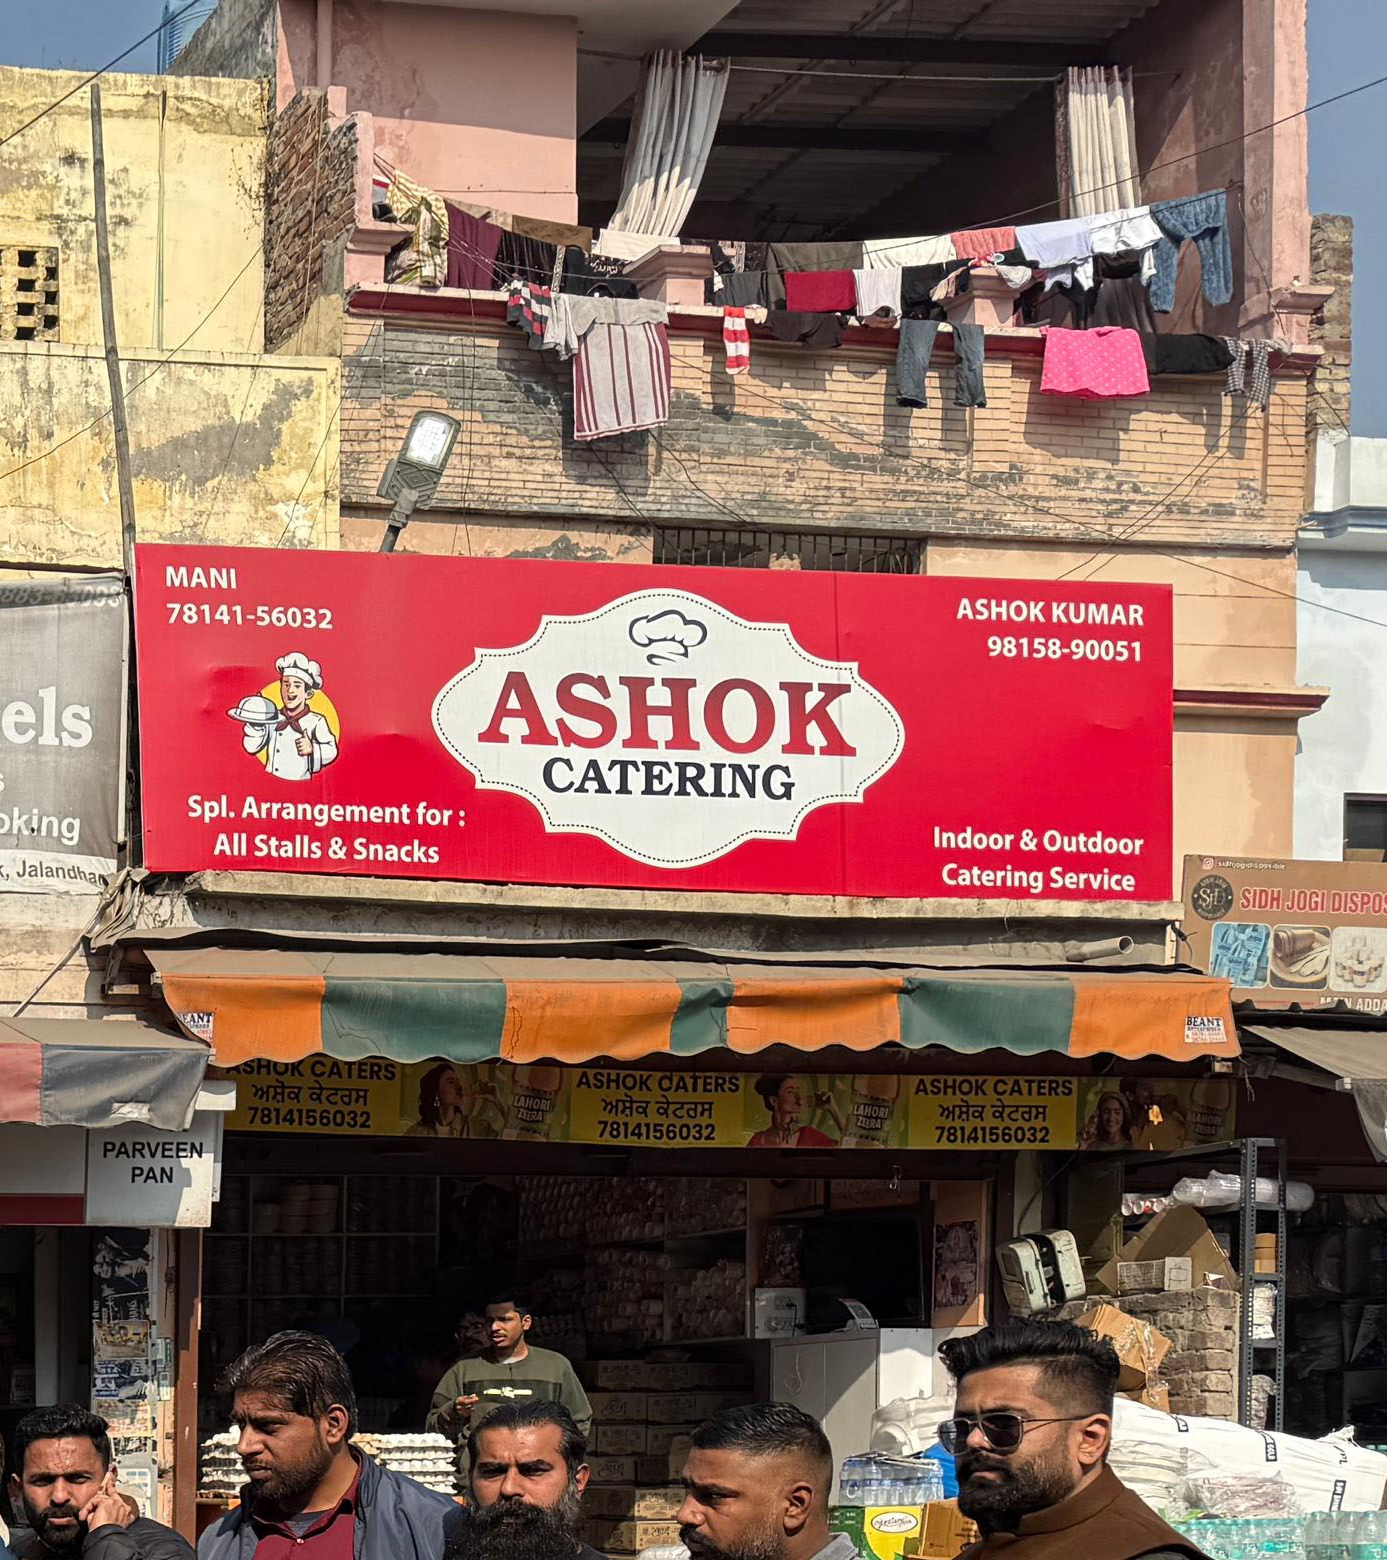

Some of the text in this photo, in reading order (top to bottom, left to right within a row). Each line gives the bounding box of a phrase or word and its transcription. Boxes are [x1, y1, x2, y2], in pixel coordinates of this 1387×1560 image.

[164, 567, 238, 590] MANI
[167, 602, 333, 629] 78141-56032
[956, 599, 1144, 626] ASHOK KUMAR
[986, 636, 1143, 662] 98158-90051
[477, 671, 857, 758] ASHOK
[542, 758, 796, 801] CATERING
[187, 795, 454, 829] Spl. Arrangement for
[212, 835, 440, 863] All Stalls & Snacks
[932, 827, 1143, 855] Indoor & Outdoor
[940, 864, 1136, 892] Catering Service
[1240, 887, 1327, 912] SIDH JOGI
[1187, 1017, 1221, 1026] BEANT
[577, 1073, 740, 1094] ASHOK CATERS
[914, 1078, 1073, 1097] ASHOK CATERS
[935, 1125, 1050, 1145] 7814156032
[102, 1141, 203, 1161] PARVEEN
[130, 1166, 174, 1185] PAN
